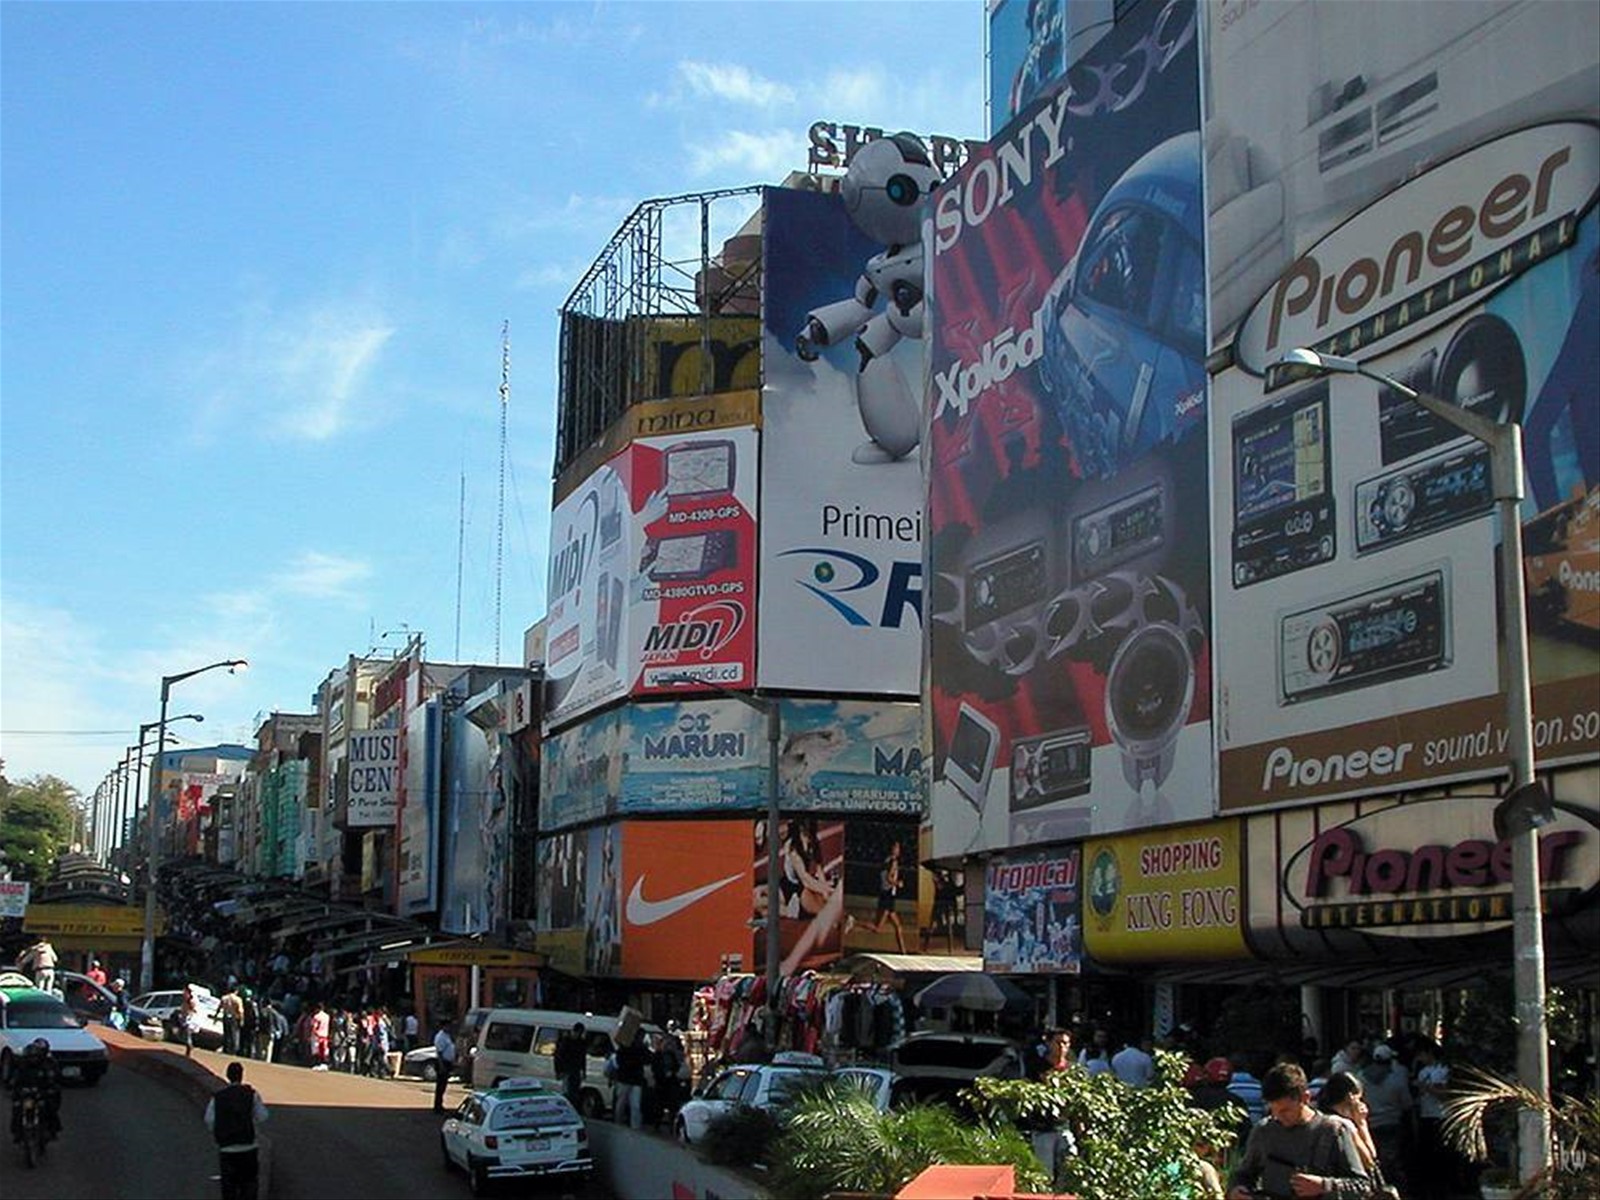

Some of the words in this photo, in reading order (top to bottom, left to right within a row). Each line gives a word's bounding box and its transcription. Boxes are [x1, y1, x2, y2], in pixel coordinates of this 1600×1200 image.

[934, 84, 1073, 256] SONY
[1266, 146, 1571, 352] Pioneer
[1267, 219, 1575, 389] IERNATIONAL
[821, 505, 922, 542] Primei
[349, 735, 399, 763] MUSI
[643, 732, 746, 761] MARURI
[1263, 743, 1413, 792] Pioneer
[1423, 710, 1600, 768] sound.von.so
[1140, 837, 1223, 877] SHOPPING
[1126, 892, 1173, 932] KING
[1180, 885, 1236, 929] FONG
